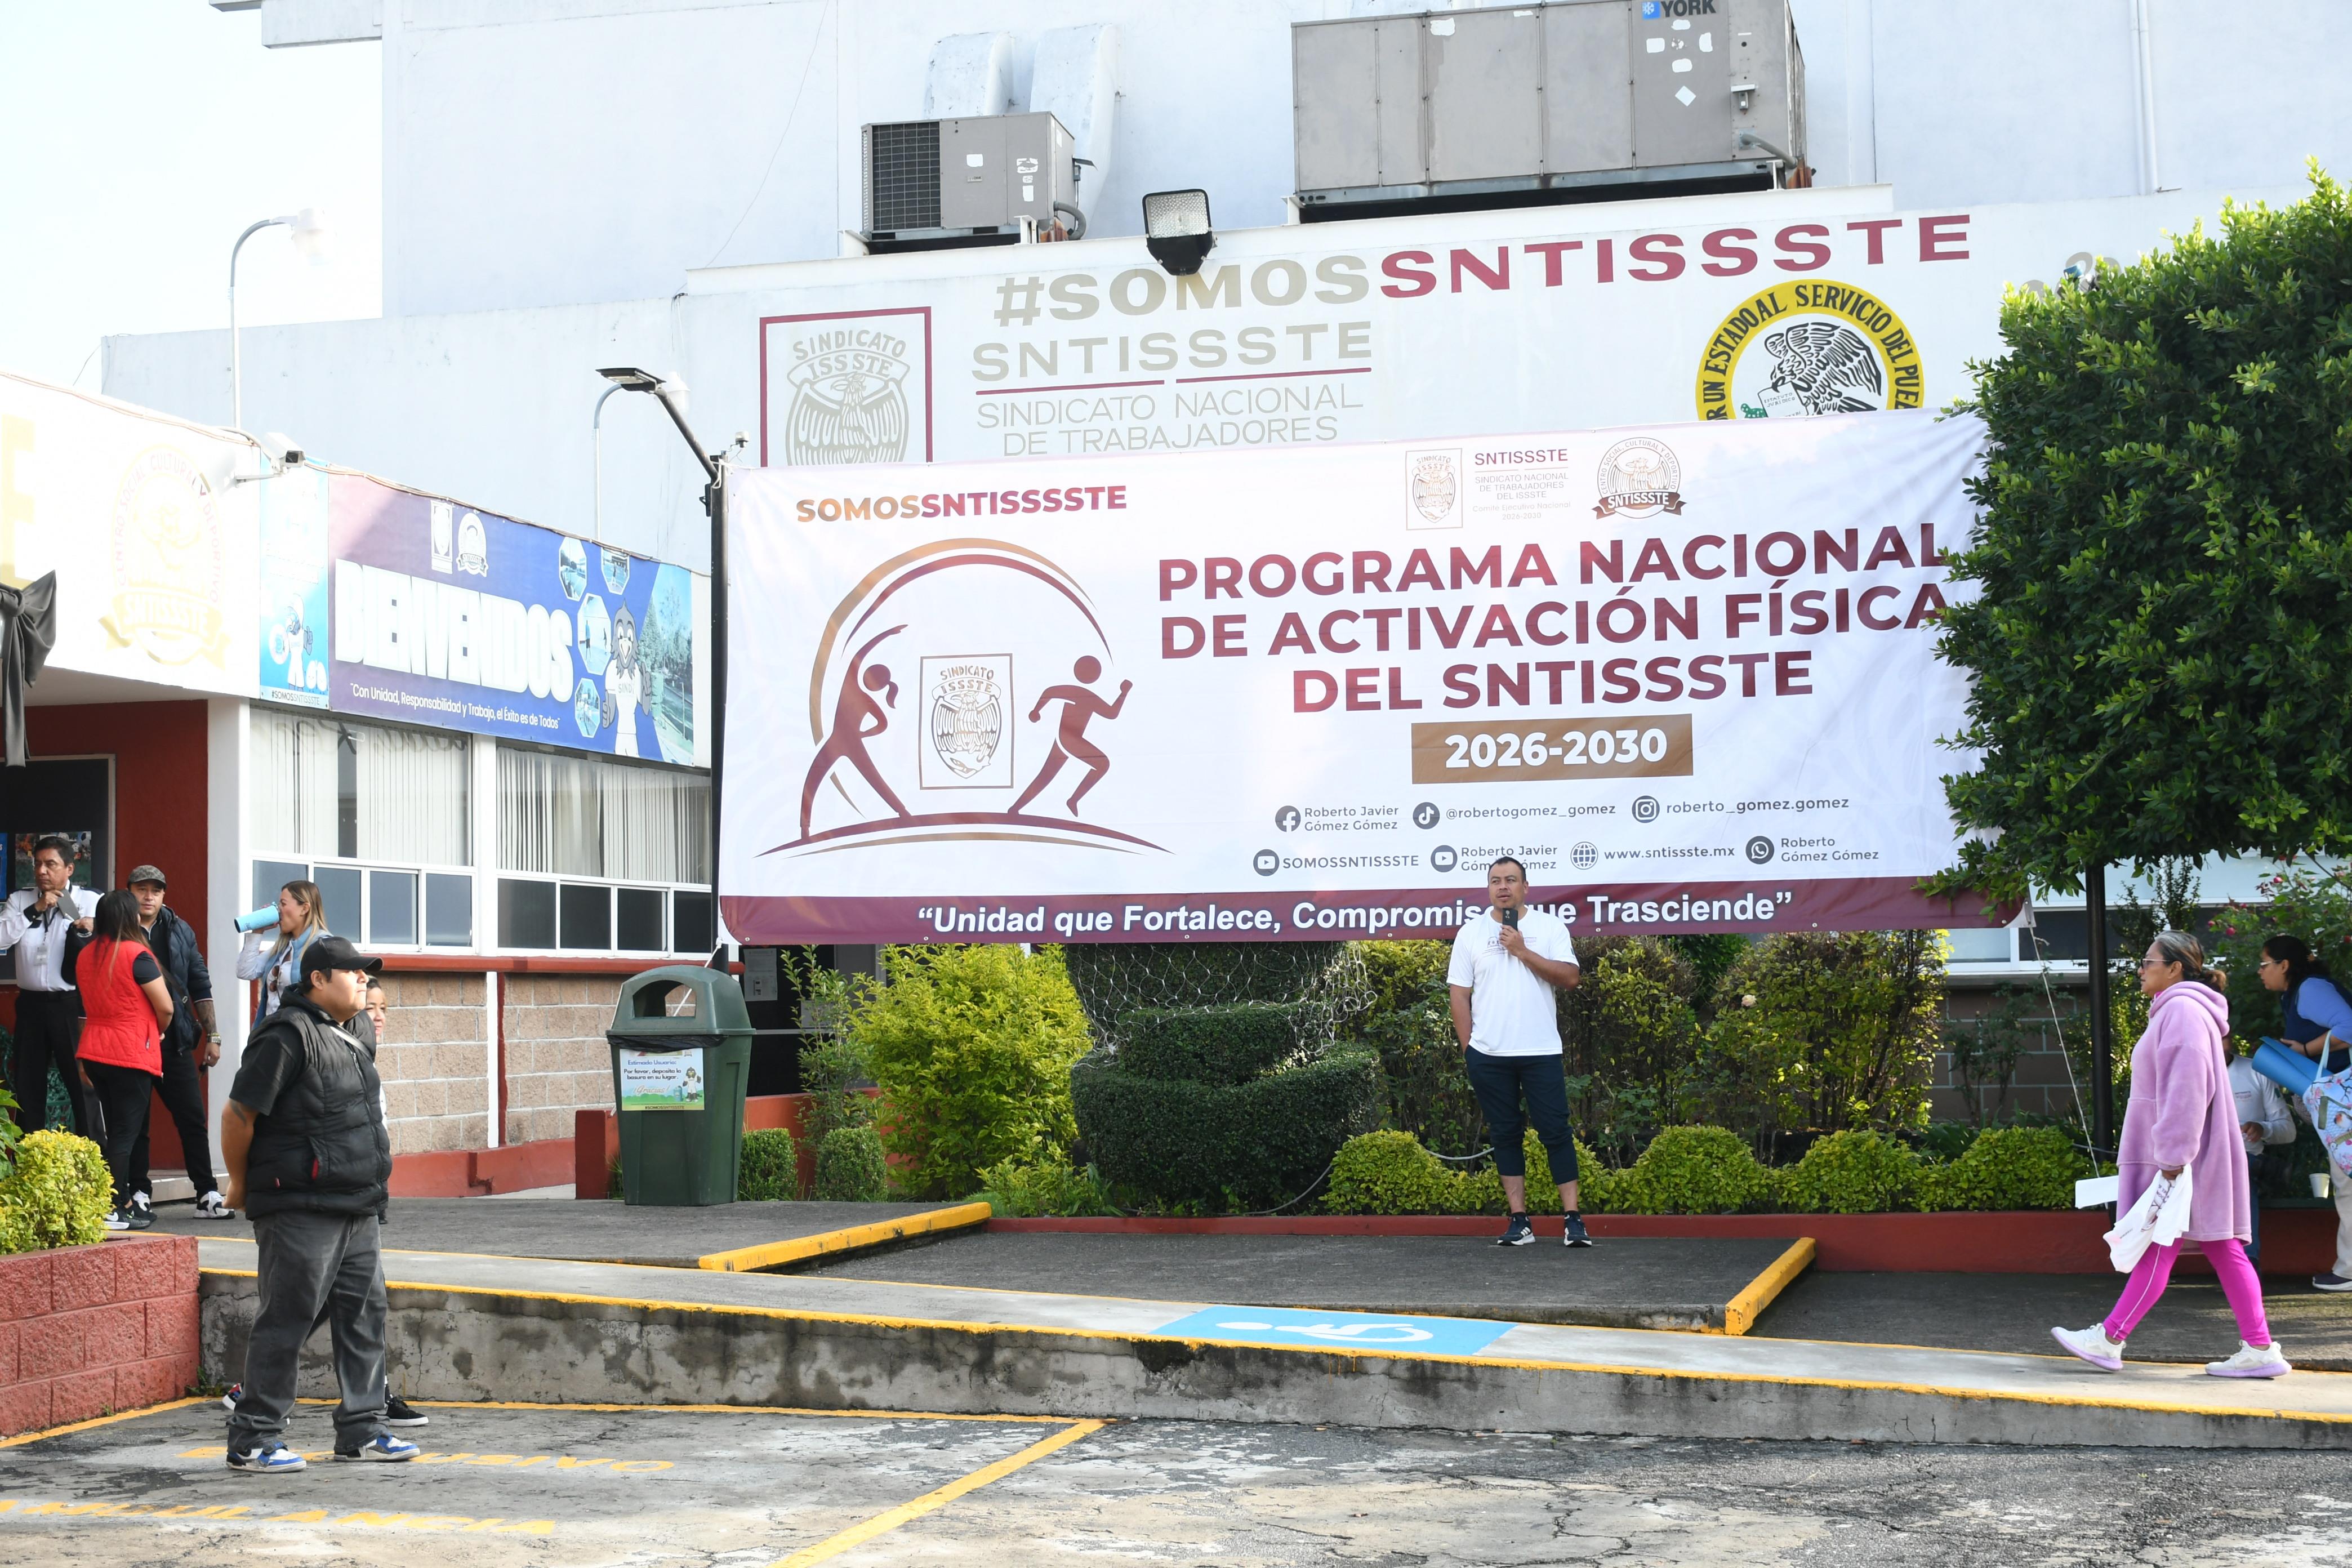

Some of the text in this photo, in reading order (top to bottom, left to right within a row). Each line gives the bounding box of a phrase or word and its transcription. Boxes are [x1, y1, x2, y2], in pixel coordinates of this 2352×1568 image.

[1660, 0, 1716, 17] YORK
[792, 329, 906, 360] SINDICATO
[972, 321, 1372, 382] SNTISSSTE
[1703, 381, 1726, 404] UN
[1794, 284, 1892, 333] SERVICIO
[1880, 327, 1913, 364] DEL
[977, 383, 1364, 429] SINDICATO NACIONAL
[1004, 416, 1338, 456] DE TRABAJADORES
[1416, 456, 1451, 464] SINDICATO
[1475, 449, 1569, 465] SNTISSSTE
[1604, 446, 1625, 466] SOCIAL,
[1625, 440, 1659, 451] CULTURAL
[1664, 452, 1678, 489] DEPORTIVO
[150, 453, 196, 487] CULTURAL
[1417, 463, 1450, 472] ISSSTE
[1475, 473, 1569, 484] SINDICATO NACIONAL
[1495, 482, 1565, 491] TRABAJADORES
[1516, 491, 1547, 500] ISSSTE
[1607, 492, 1669, 509] SNTISSSTE
[1502, 502, 1535, 512] Ejecutivo
[1159, 523, 1950, 602] PROGRAMA NACIONAL
[1161, 578, 1949, 660] DE ACTIVACIÓN FÍSICA
[335, 558, 574, 702] BIENVENIDOS
[940, 665, 994, 681] SINDICATO
[941, 679, 993, 694] ISSSTE
[1293, 651, 1814, 714] DEL SNTISSSTE
[371, 687, 400, 706] Unidad,
[401, 692, 461, 714] Responsabilidad
[462, 704, 467, 718] y
[468, 703, 496, 721] Trabajo,
[497, 707, 503, 720] el
[504, 706, 519, 723] Éxito
[520, 714, 529, 724] es
[529, 712, 538, 725] de
[1445, 727, 1668, 769] 2026-2030
[1304, 805, 1399, 818] Roberto Javier
[1446, 805, 1616, 819] @robertogomez_gomez
[1667, 797, 1850, 814] roberto_gomez.gomez
[1304, 819, 1398, 832] Gómez Gómez
[1781, 836, 1836, 848] Roberto
[1462, 845, 1558, 857] Roberto Javier
[1604, 847, 1735, 859] www.sntissste.mx
[1781, 849, 1879, 862] Gómez Gómez
[1282, 855, 1419, 868] SOMOSSNTISSSTE
[1462, 859, 1556, 871] Góm ómez
[1054, 908, 1113, 937] que
[1123, 905, 1281, 934] Fortalece,
[0, 1499, 556, 1535] MBULANCIA
